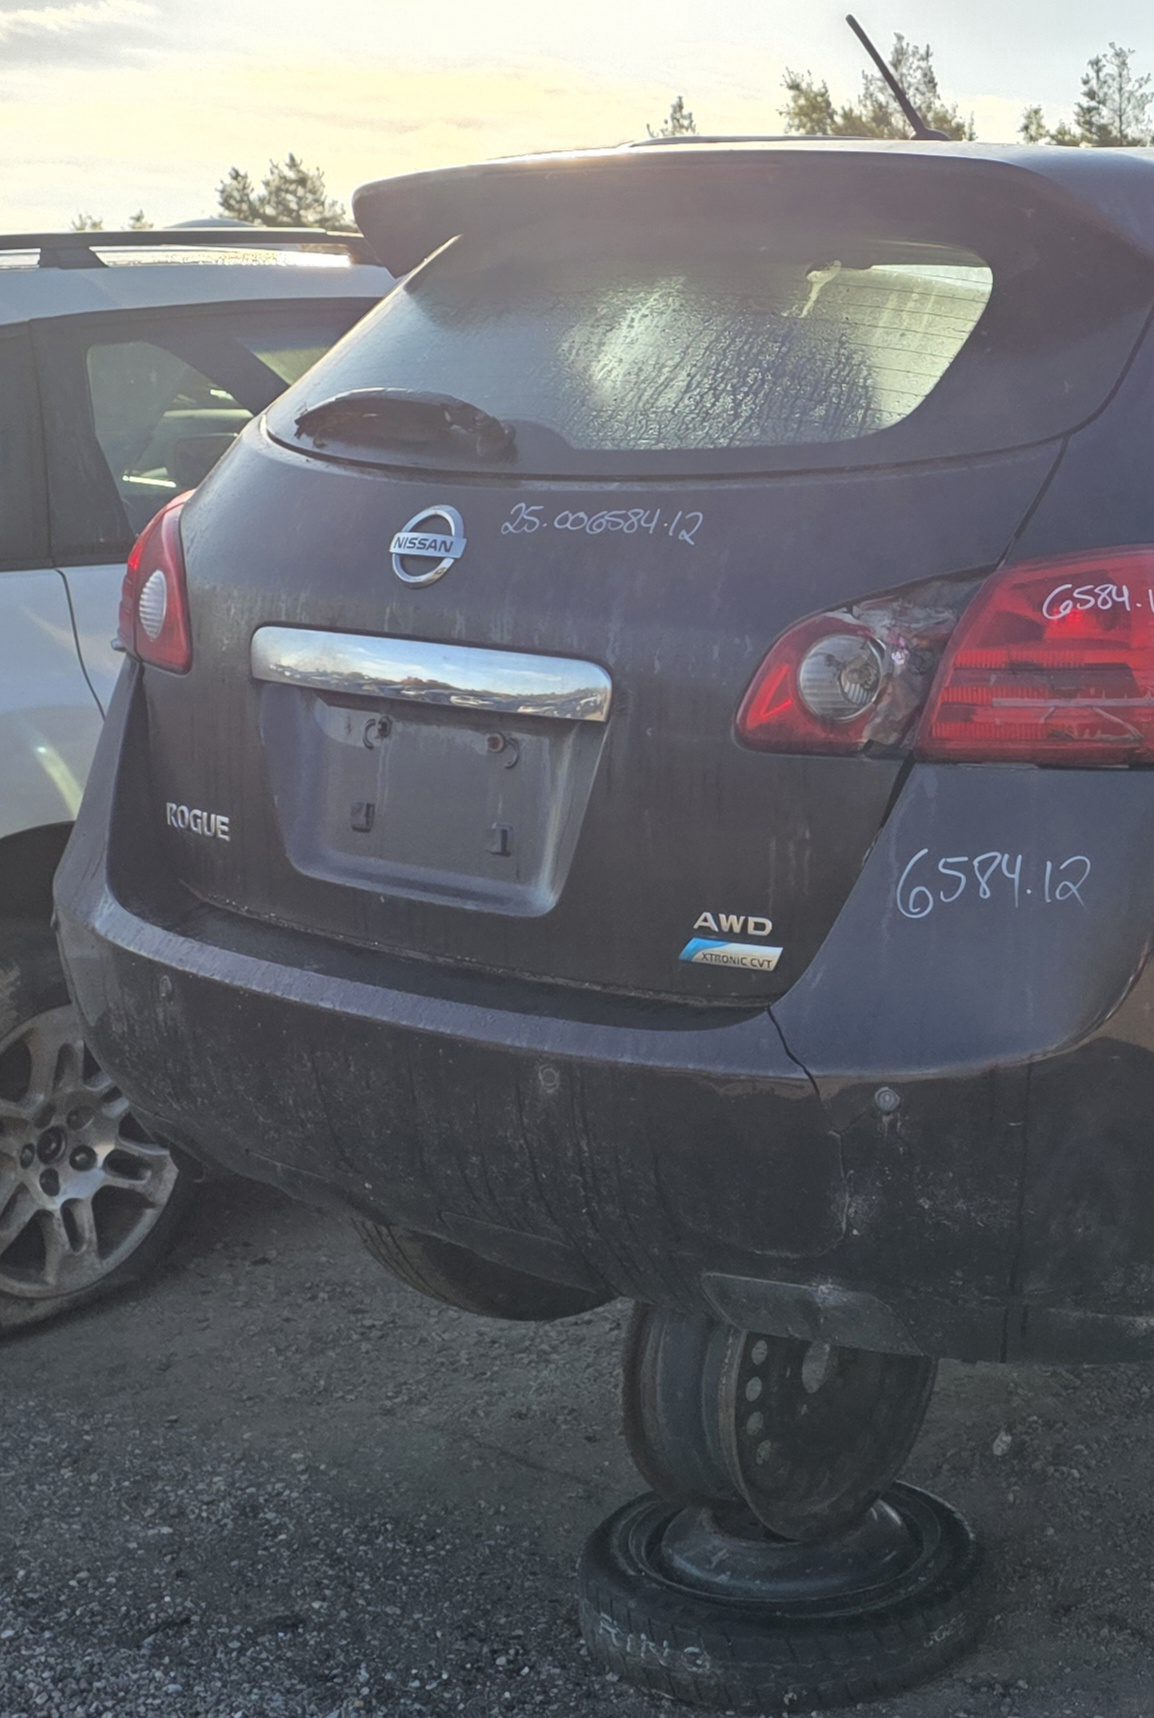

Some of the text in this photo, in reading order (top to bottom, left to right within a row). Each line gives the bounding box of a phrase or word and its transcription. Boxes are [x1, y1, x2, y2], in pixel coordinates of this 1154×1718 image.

[500, 502, 703, 545] 25.006584.12
[393, 535, 455, 553] NISSAN
[166, 802, 231, 842] ROGUE
[896, 848, 1091, 918] 6584.12
[693, 911, 773, 936] AWD
[701, 952, 773, 969] XTRONIC CVT
